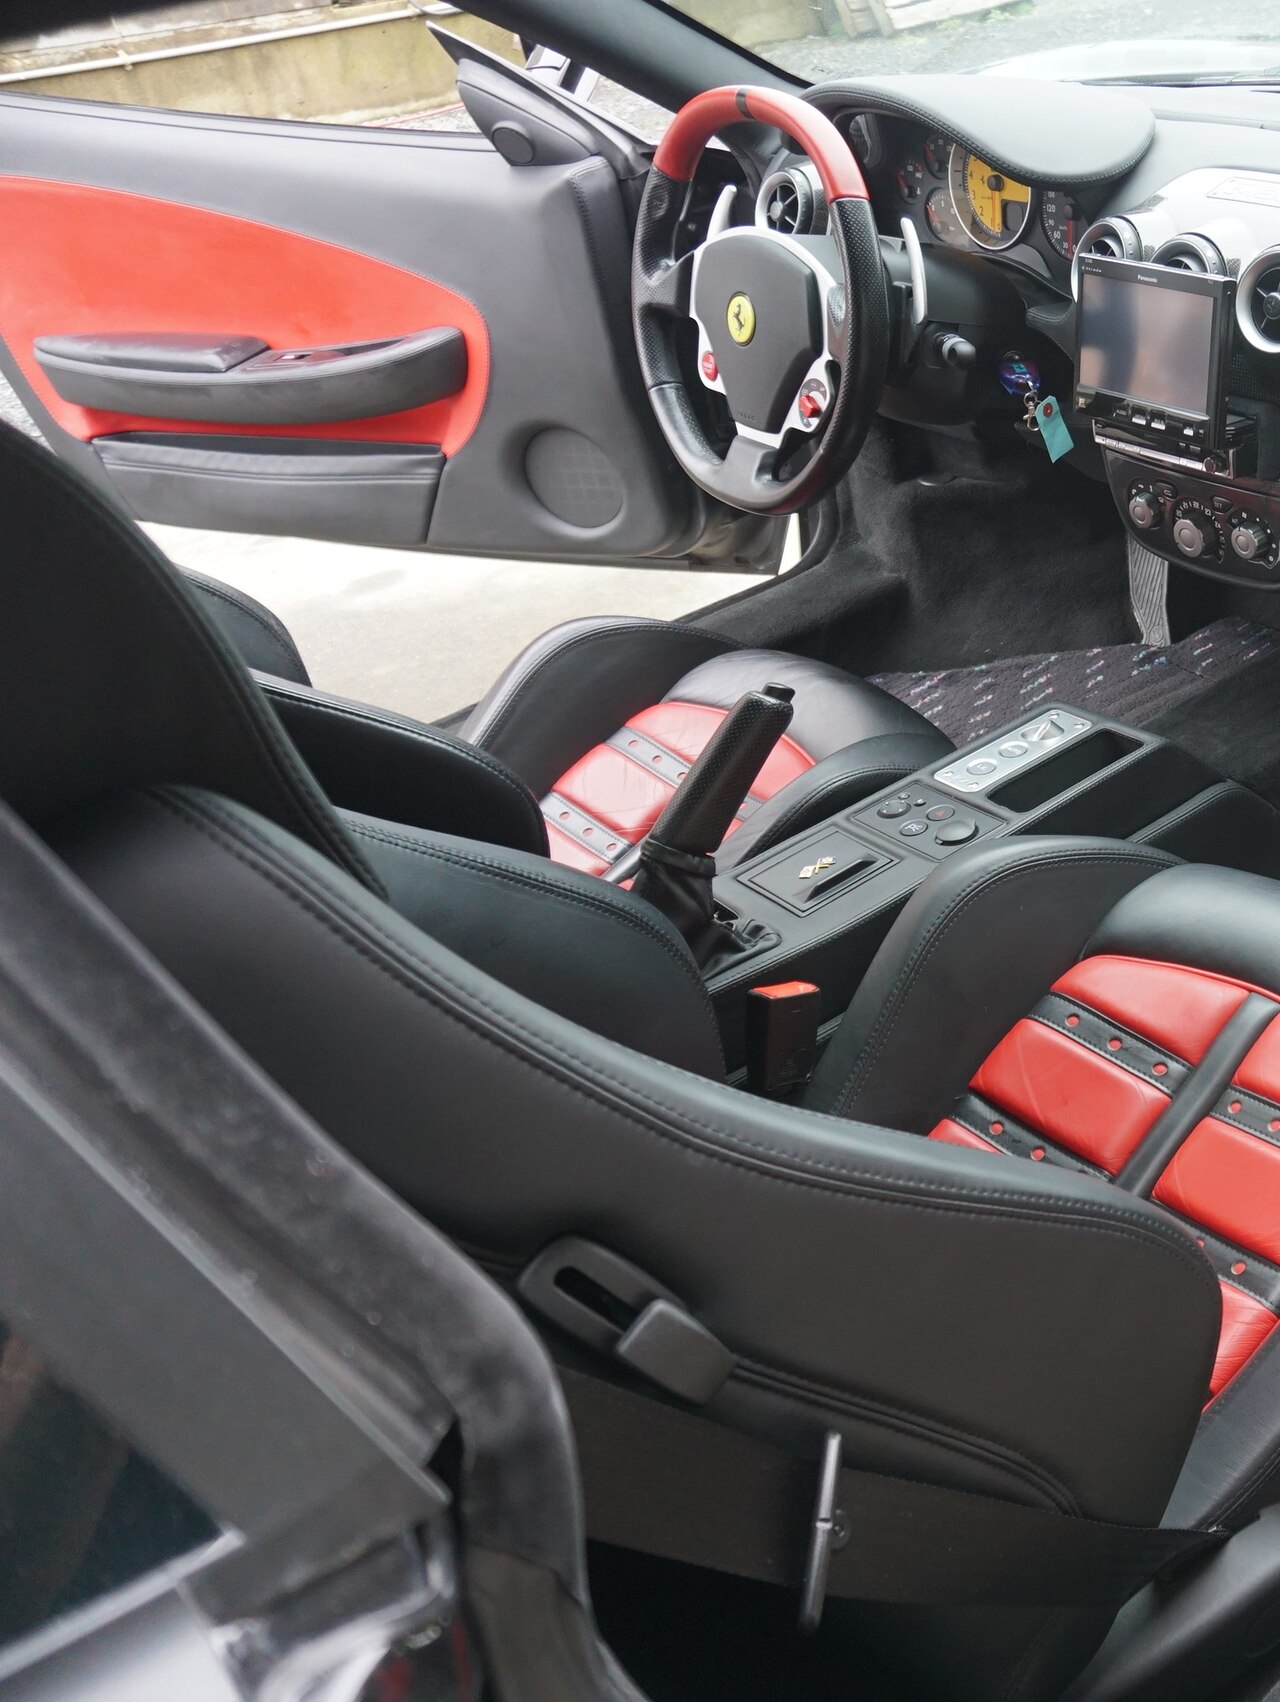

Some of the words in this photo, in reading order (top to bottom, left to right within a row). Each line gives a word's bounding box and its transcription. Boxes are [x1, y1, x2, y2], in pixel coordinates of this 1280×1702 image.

[1047, 204, 1056, 212] 120
[1053, 231, 1061, 239] 60
[1137, 275, 1158, 283] Panasonic
